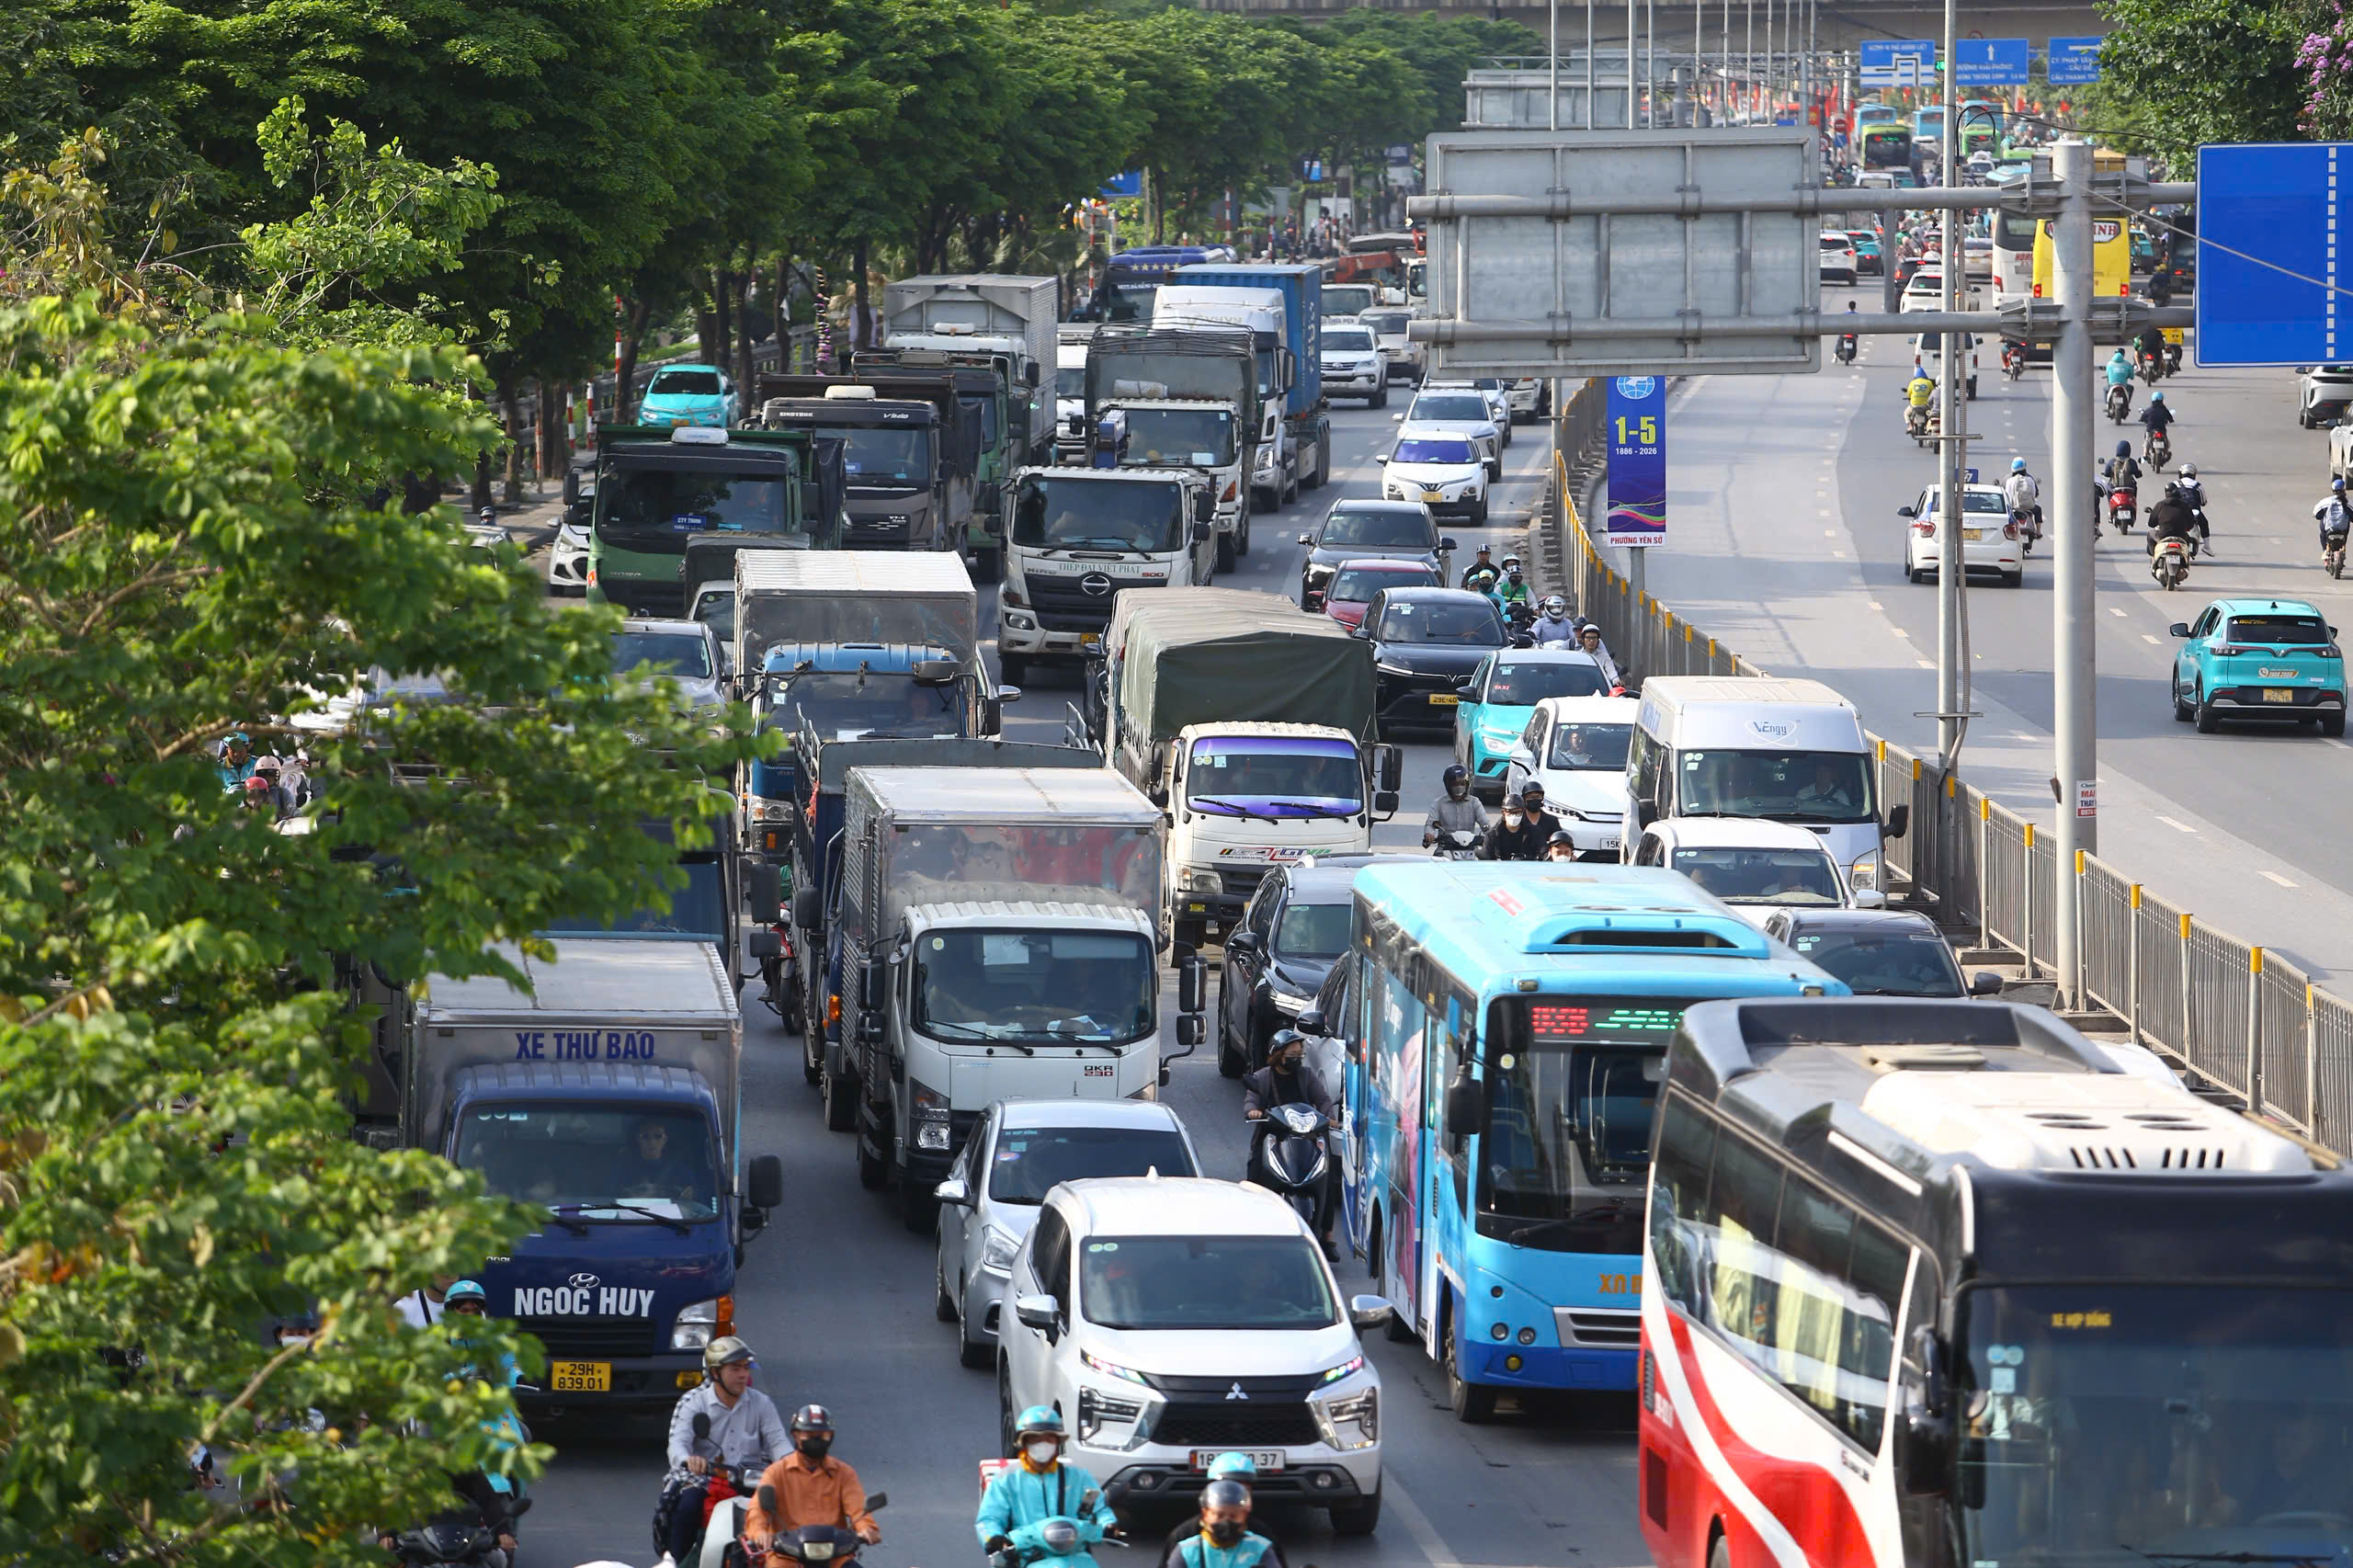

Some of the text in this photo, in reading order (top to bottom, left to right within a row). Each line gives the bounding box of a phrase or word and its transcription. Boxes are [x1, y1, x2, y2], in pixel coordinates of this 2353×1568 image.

[1615, 416, 1656, 444] 1-5
[516, 1029, 654, 1060] XE THƯ BÁO
[598, 1287, 655, 1318] HUY
[558, 1377, 603, 1390] 839.01
[568, 1363, 595, 1376] 29H
